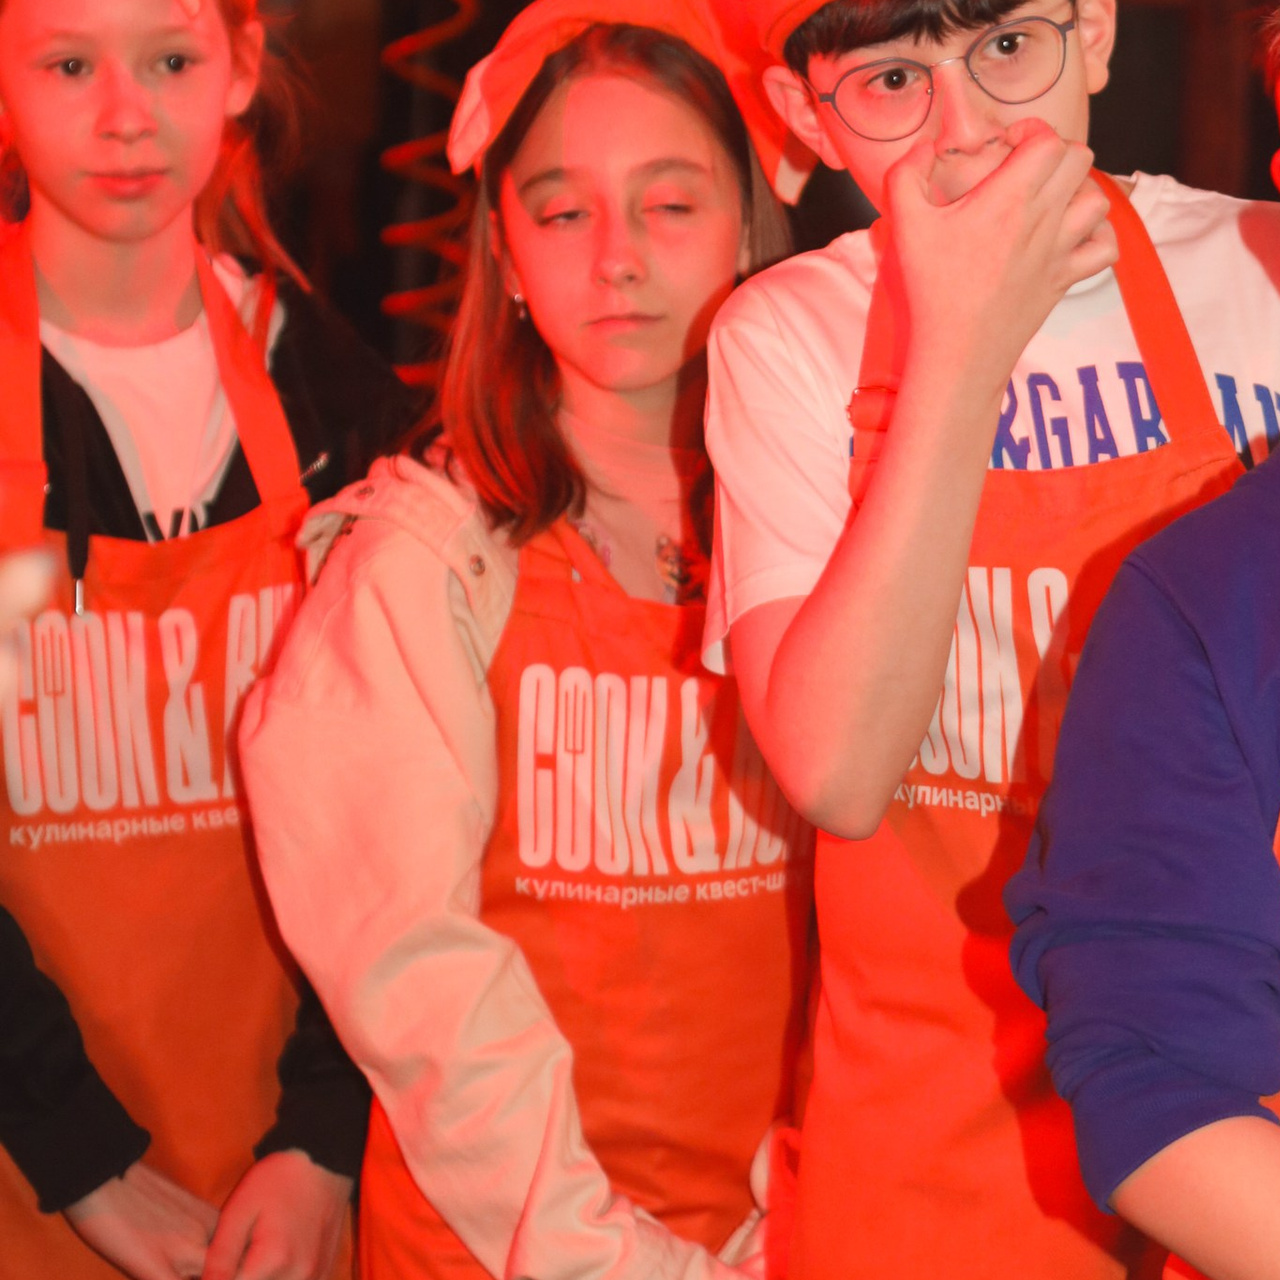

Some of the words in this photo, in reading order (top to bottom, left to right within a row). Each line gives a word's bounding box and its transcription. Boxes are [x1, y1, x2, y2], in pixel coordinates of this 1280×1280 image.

[2, 606, 159, 816] COOK
[158, 607, 217, 804] &
[516, 662, 670, 877] COOK
[9, 813, 186, 851] кулинарные
[515, 876, 689, 909] кулинарные
